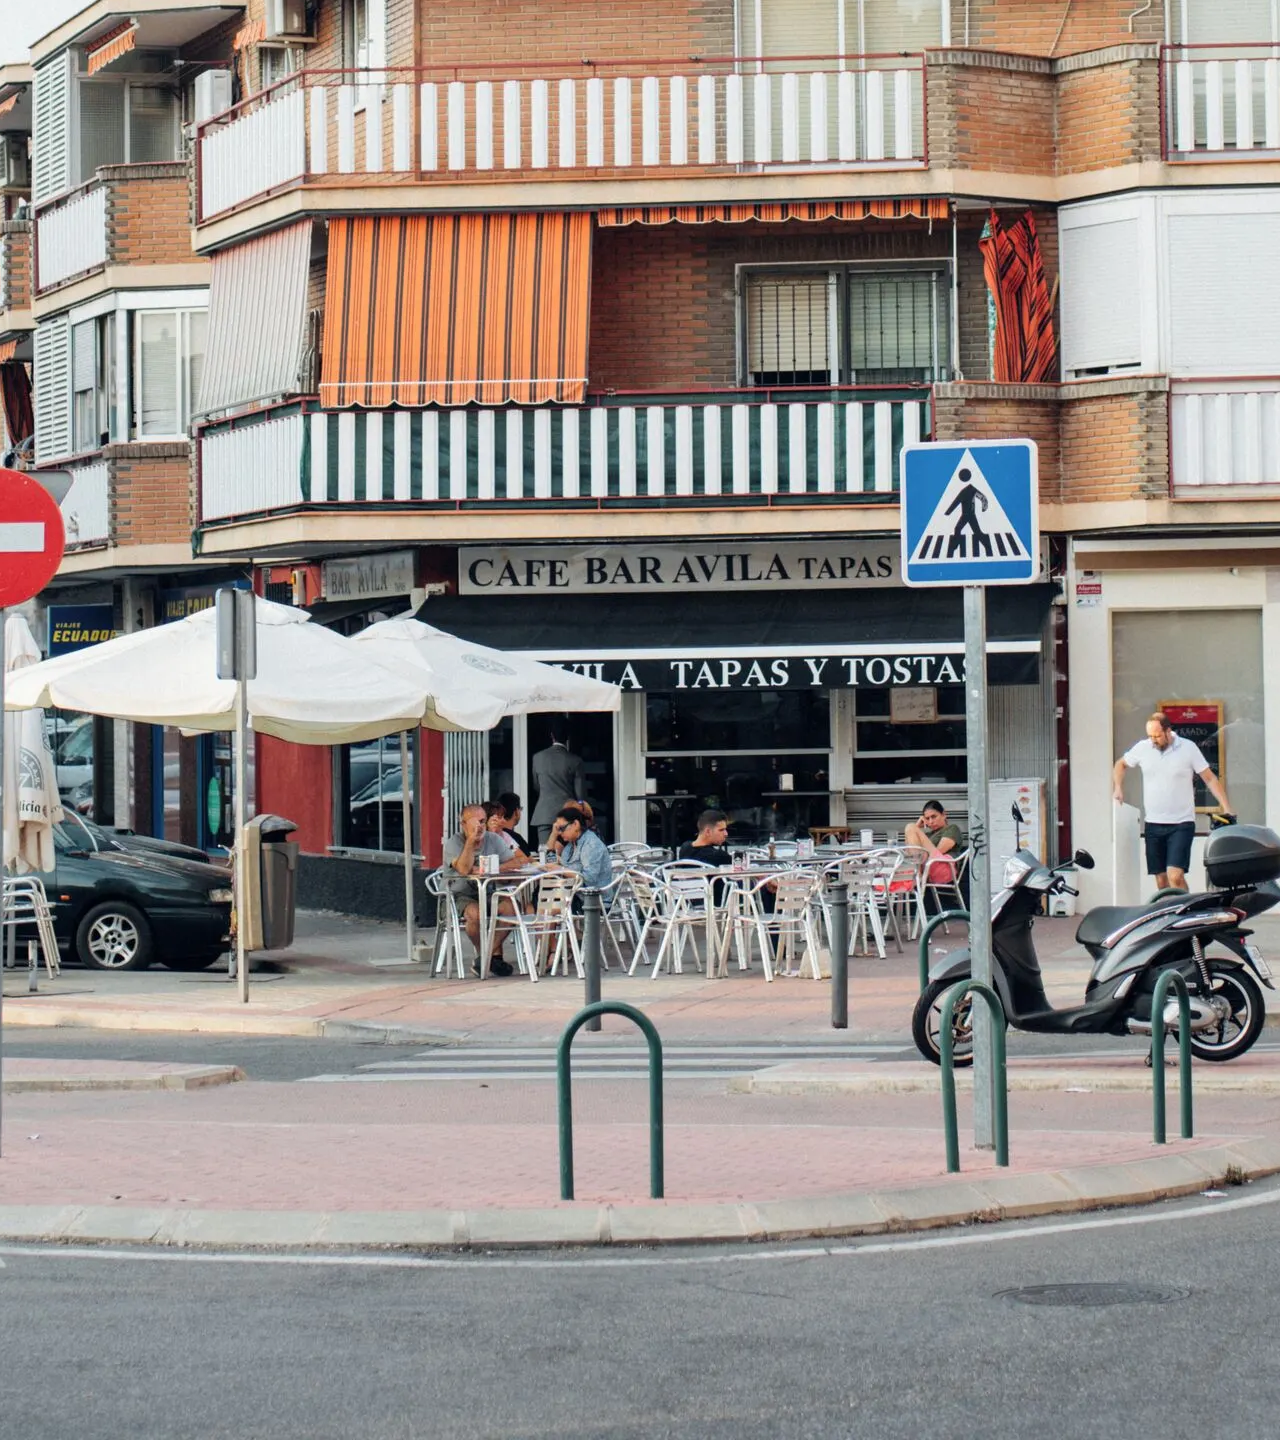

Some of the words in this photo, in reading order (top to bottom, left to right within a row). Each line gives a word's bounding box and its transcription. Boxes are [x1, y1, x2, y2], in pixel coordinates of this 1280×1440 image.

[468, 558, 570, 587] CAFE
[583, 556, 665, 585] BAR
[672, 553, 791, 583] AVILA
[798, 555, 893, 580] TAPAS
[669, 658, 790, 689] TAPAS
[804, 658, 829, 686] Y
[841, 656, 967, 685] TOSTA
